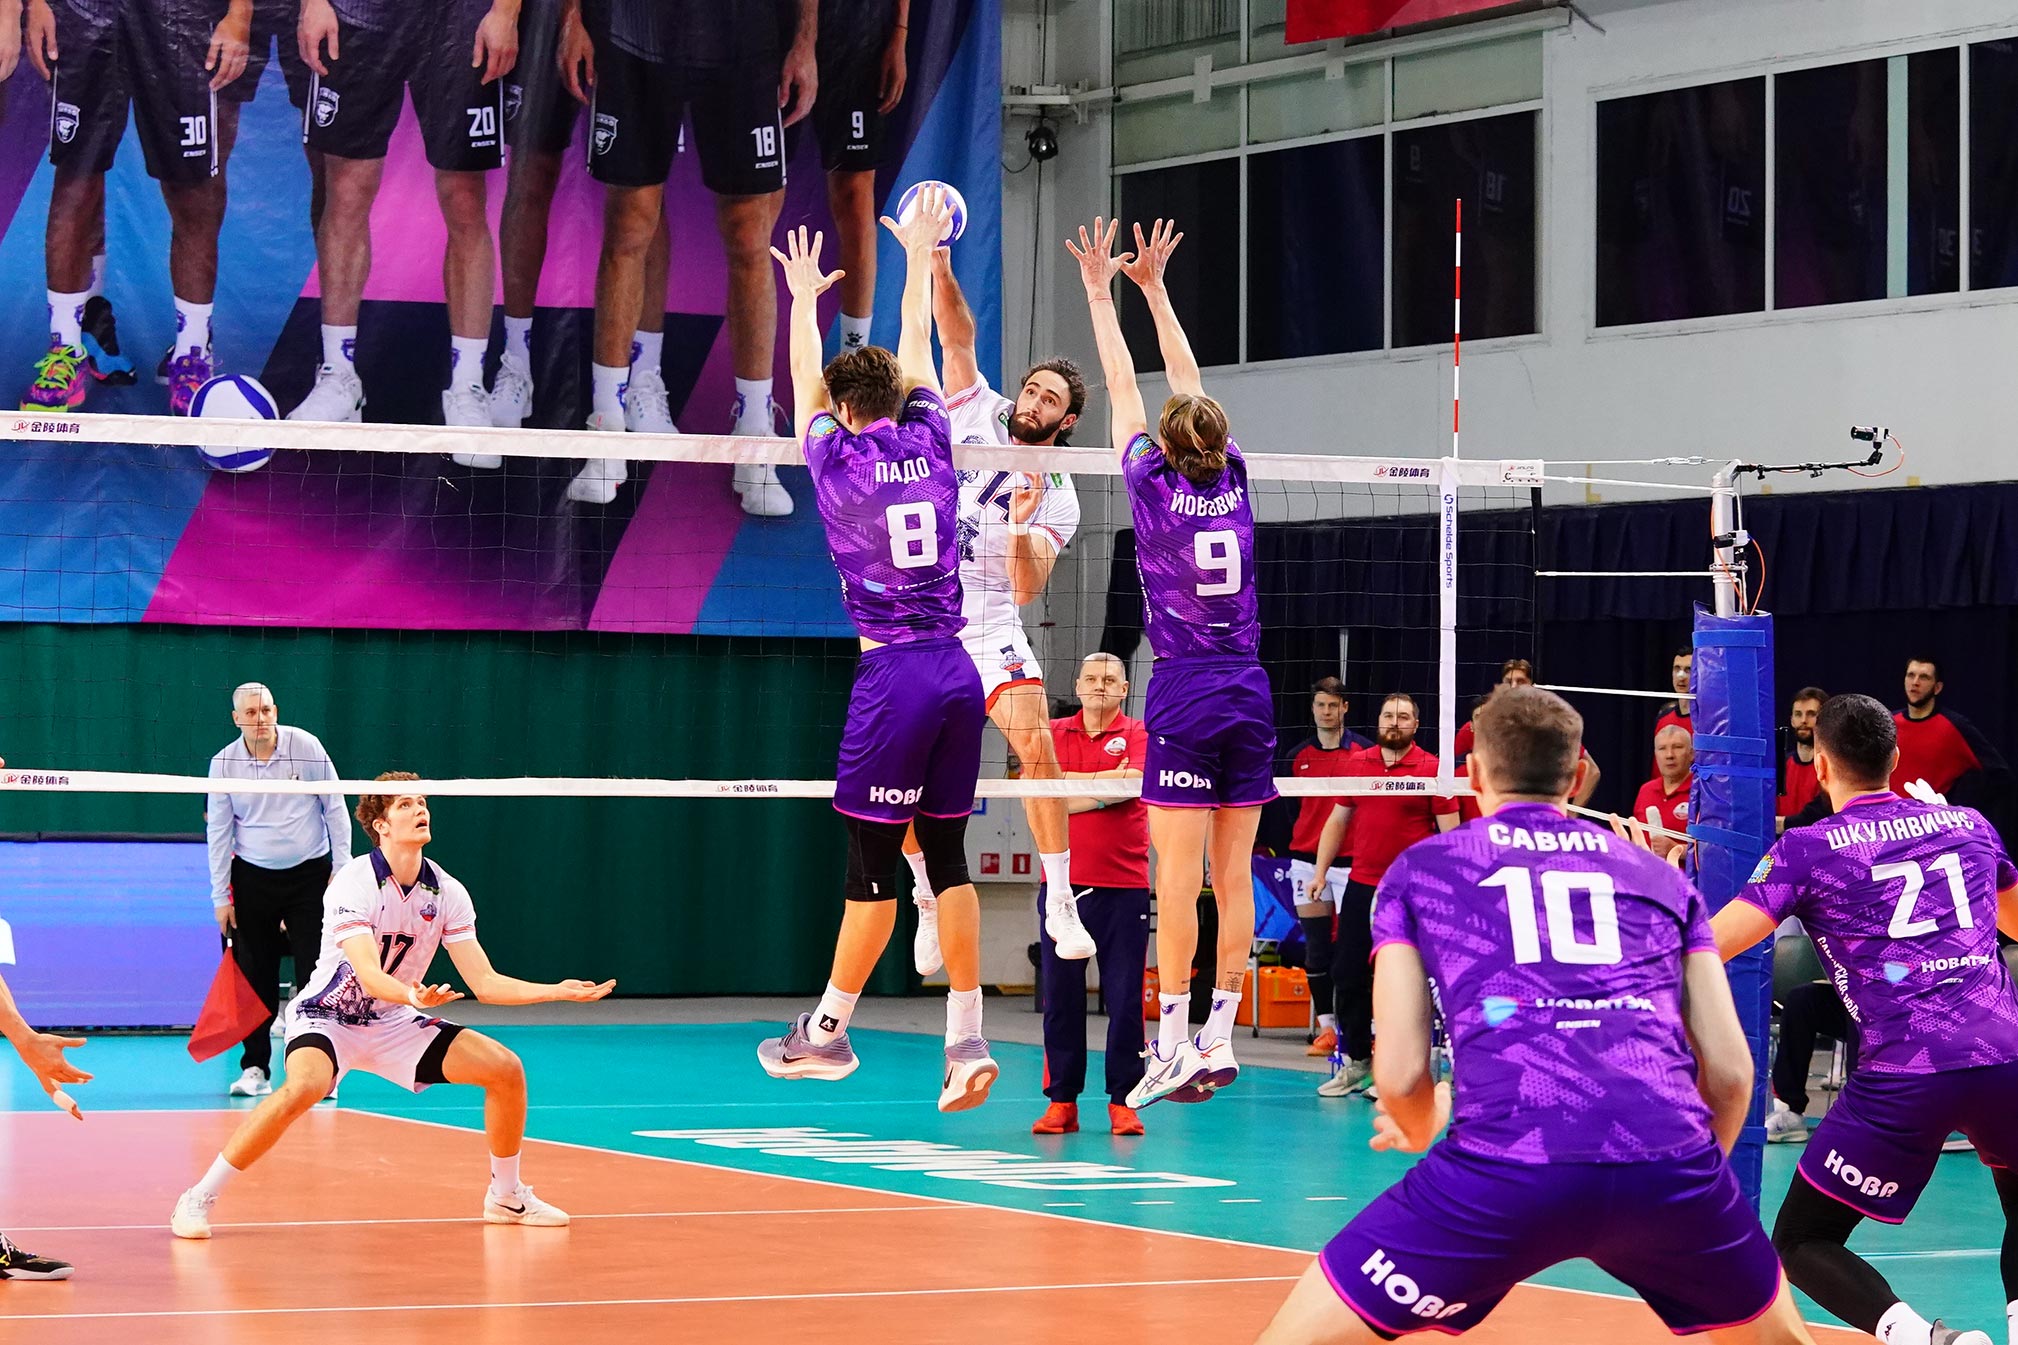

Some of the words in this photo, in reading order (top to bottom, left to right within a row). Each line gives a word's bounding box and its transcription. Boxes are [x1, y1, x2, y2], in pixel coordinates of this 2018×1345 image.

[179, 115, 207, 146] 30
[466, 106, 496, 137] 20
[852, 111, 864, 139] 9
[750, 125, 776, 158] 18
[31, 421, 80, 433] 金陵体育
[874, 456, 931, 485] ПАДО
[1389, 467, 1430, 478] 金陵体育
[885, 501, 939, 569] 8
[1445, 505, 1454, 550] Schelde
[1193, 529, 1242, 597] 9
[1444, 552, 1454, 589] Sports
[1488, 823, 1609, 854] САВИН
[1825, 810, 1975, 851] ШКУЛЯВИЧУС
[1870, 852, 1975, 939] 21
[1477, 865, 1624, 965] 10
[379, 932, 417, 976] 17
